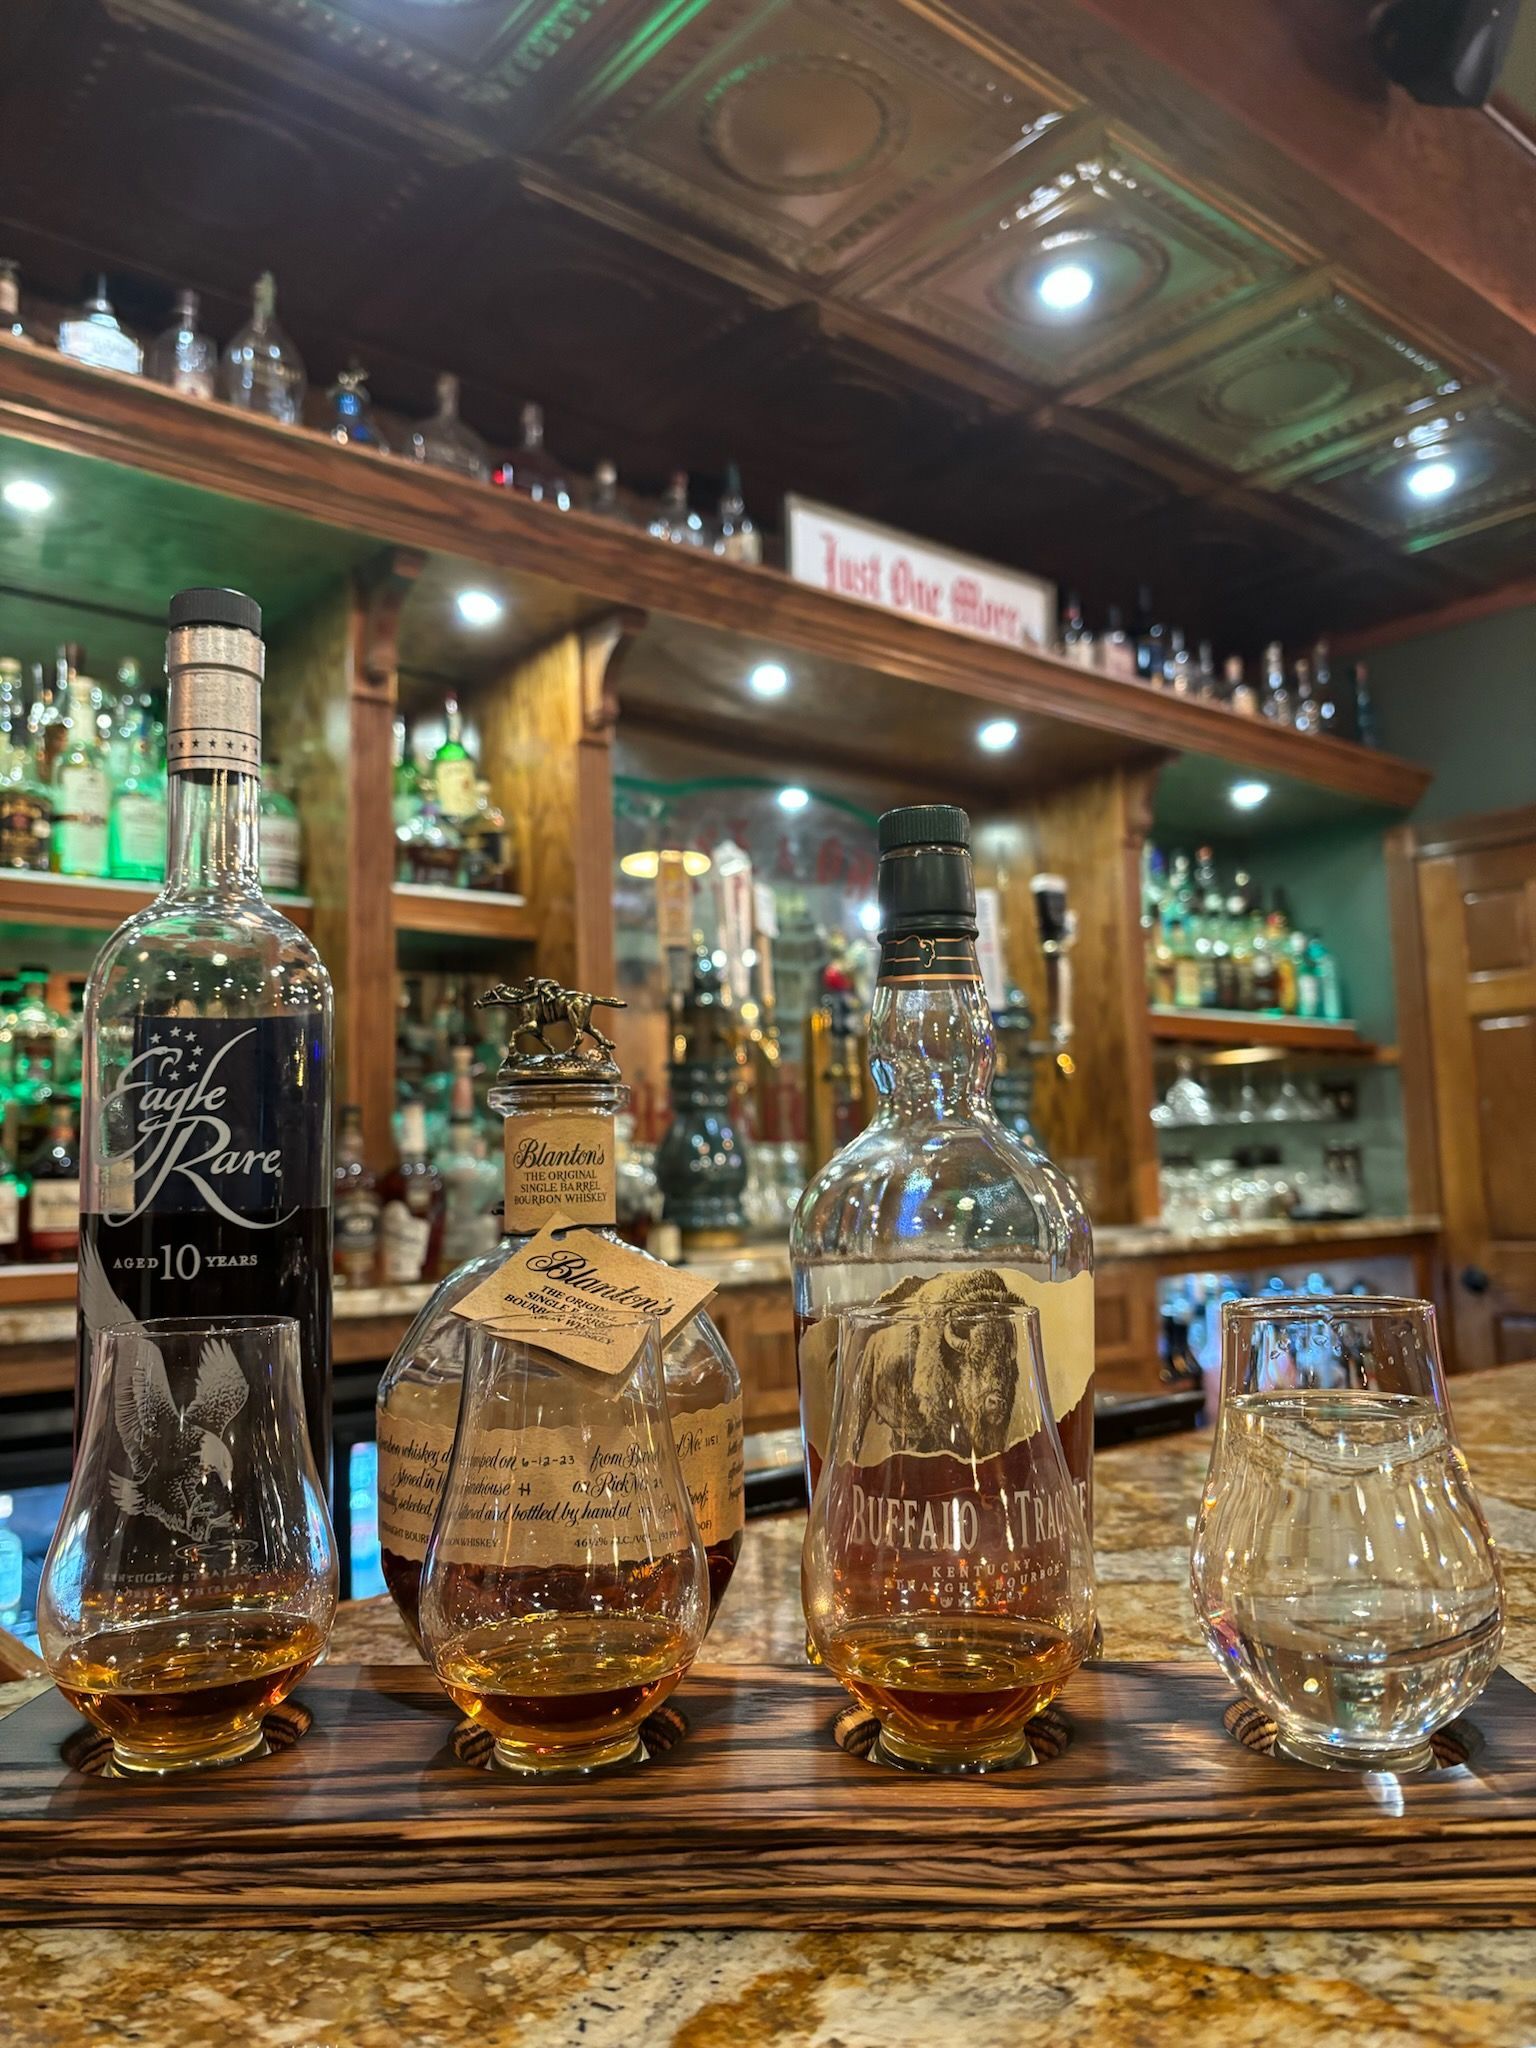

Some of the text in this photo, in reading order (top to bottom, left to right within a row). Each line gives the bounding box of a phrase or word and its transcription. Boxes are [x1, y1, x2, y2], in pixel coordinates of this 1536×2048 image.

[820, 531, 881, 600] Just
[890, 559, 941, 617] One
[513, 1137, 605, 1169] Blanton's
[520, 1181, 601, 1193] SINGLE BARREL
[523, 1169, 597, 1182] THE ORIGINAL
[514, 1192, 607, 1206] BOURBON WHISKEY
[113, 1243, 259, 1281] AGED 10 YEARS
[526, 1250, 676, 1316] Blanton's
[525, 1291, 614, 1329] SINGLE BARRE
[541, 1285, 614, 1321] THE ORIGIN
[401, 1439, 442, 1472] whiskey
[500, 1455, 517, 1472] on
[521, 1455, 575, 1467] 6-12-23
[590, 1445, 623, 1473] from
[424, 1473, 435, 1491] in
[518, 1482, 531, 1497] H
[590, 1471, 629, 1498] Rick
[398, 1494, 433, 1519] selected,
[483, 1504, 512, 1524] and
[511, 1501, 561, 1524] bottled
[560, 1501, 580, 1527] by
[580, 1500, 621, 1521] hand
[852, 1484, 979, 1551] BUFFALO
[460, 1537, 500, 1549] WHISKEY
[932, 1558, 1032, 1579] KENTUCKY
